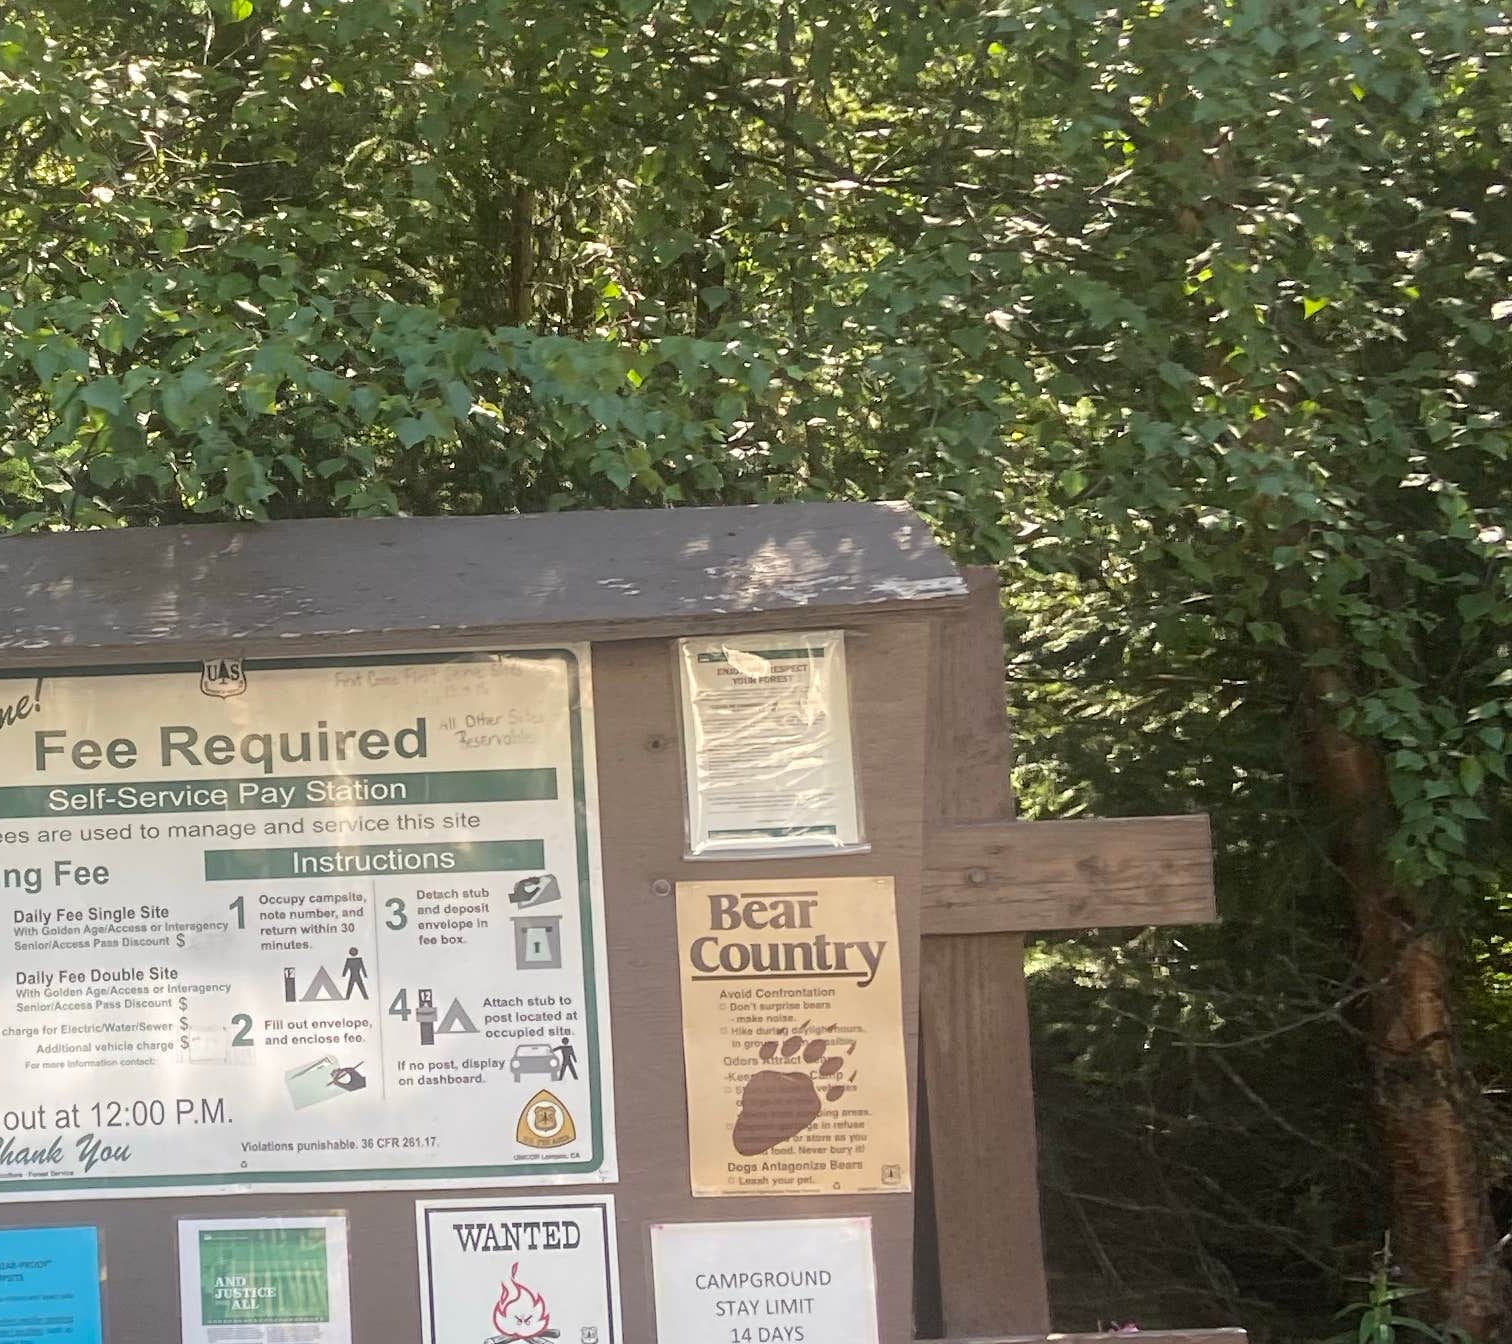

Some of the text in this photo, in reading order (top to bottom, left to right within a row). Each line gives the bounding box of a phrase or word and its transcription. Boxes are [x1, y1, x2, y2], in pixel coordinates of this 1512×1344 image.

[34, 717, 428, 774] Fee Required
[48, 779, 407, 812] Self-Service Pay Station
[37, 830, 72, 843] are
[80, 824, 132, 842] used
[139, 824, 161, 840] to
[167, 823, 257, 841] manage
[263, 817, 305, 836] and
[312, 815, 389, 834] service
[397, 813, 435, 832] this
[442, 812, 481, 829] site
[291, 849, 456, 874] Instructions
[53, 860, 110, 887] Fee
[258, 891, 367, 906] Occupy campsite,
[416, 888, 490, 900] Detach stub
[13, 905, 170, 926] Daily Fee Single Site
[229, 895, 246, 930] 1
[259, 907, 364, 920] note number, and
[384, 897, 408, 931] 3
[417, 902, 490, 915] and deposit
[708, 891, 819, 931] Bear
[13, 921, 229, 937] With Golden Age/Access or Interagency
[260, 922, 355, 936] return within 30
[418, 918, 489, 931] envelope in
[13, 932, 186, 951] Senior/Access Pass Discount $
[260, 940, 312, 951] minutes.
[418, 934, 468, 946] fee box.
[689, 934, 887, 988] Country
[15, 966, 179, 988] Daily Fee Double Site
[483, 994, 572, 1008] Attach stub to
[719, 987, 835, 999] Avoid Confrontation
[388, 988, 431, 1022] 4 12
[729, 1002, 757, 1012] Don't
[264, 1017, 373, 1030] Fill out envelope,
[484, 1009, 579, 1025] post located at
[1, 1026, 39, 1039] charge
[41, 1025, 58, 1035] for
[60, 1022, 173, 1036] Electric/Water/Sewer
[231, 1013, 255, 1047] 2
[485, 1025, 575, 1039] occupied site.
[36, 1040, 174, 1054] Additional vehicle charge
[264, 1032, 366, 1046] and enclose fee.
[397, 1057, 506, 1073] If no post, display
[398, 1073, 486, 1086] on dashboard.
[2, 1105, 45, 1132] out
[55, 1103, 81, 1129] at
[90, 1098, 165, 1129] 12:00
[175, 1096, 234, 1126] P.M.
[75, 1132, 133, 1173] You
[241, 1140, 295, 1153] Violations
[297, 1138, 358, 1153] punishable.
[361, 1138, 374, 1150] 36
[376, 1137, 400, 1149] CFR
[727, 1160, 863, 1174] Dogs Antagonize Bears
[452, 1220, 581, 1252] WANTED
[214, 1276, 247, 1288] AND
[695, 1269, 832, 1291] CAMPGROUND
[214, 1287, 277, 1300] JUSTICE
[231, 1299, 260, 1311] ALL
[715, 1296, 816, 1318] STAY LIMIT
[730, 1325, 805, 1344] 14 DAYS
